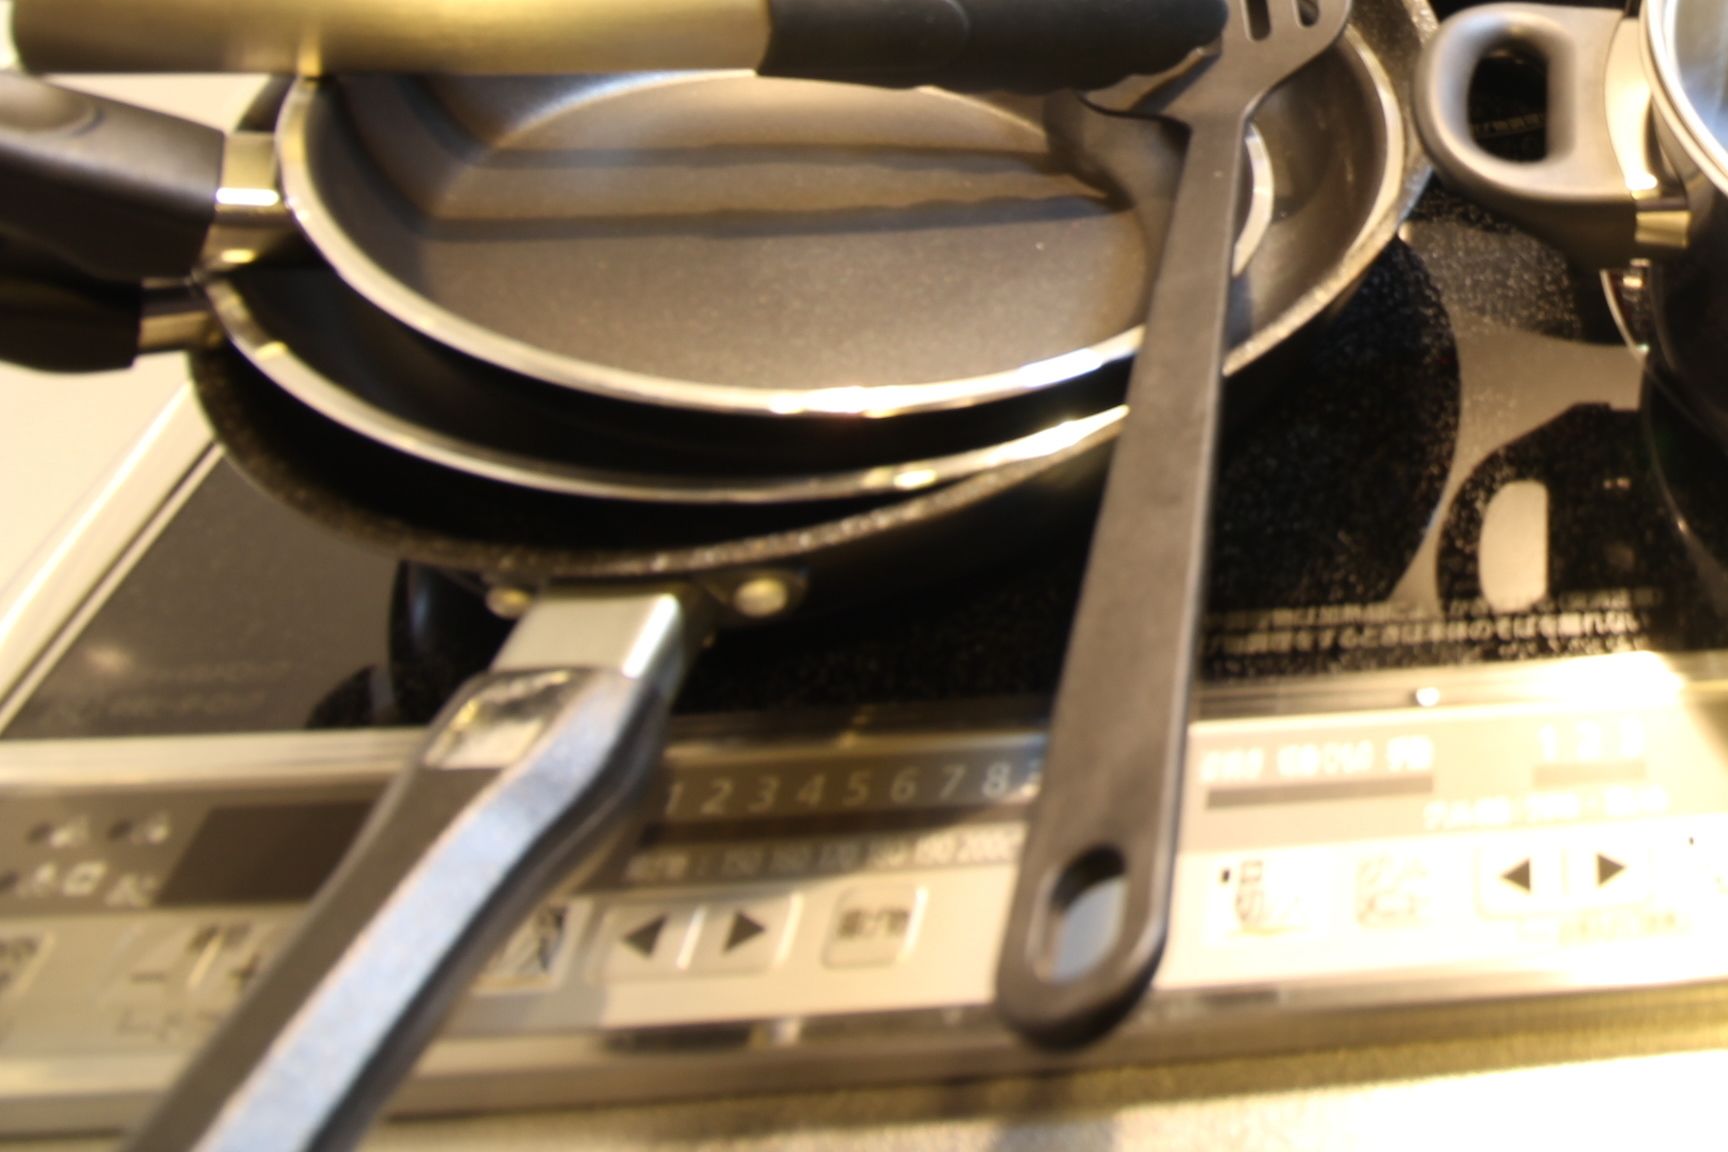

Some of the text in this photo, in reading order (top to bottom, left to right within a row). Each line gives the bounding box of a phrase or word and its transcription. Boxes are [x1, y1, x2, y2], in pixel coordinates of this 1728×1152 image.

[664, 760, 1013, 817] 1 2 3 4 5 6 7 8
